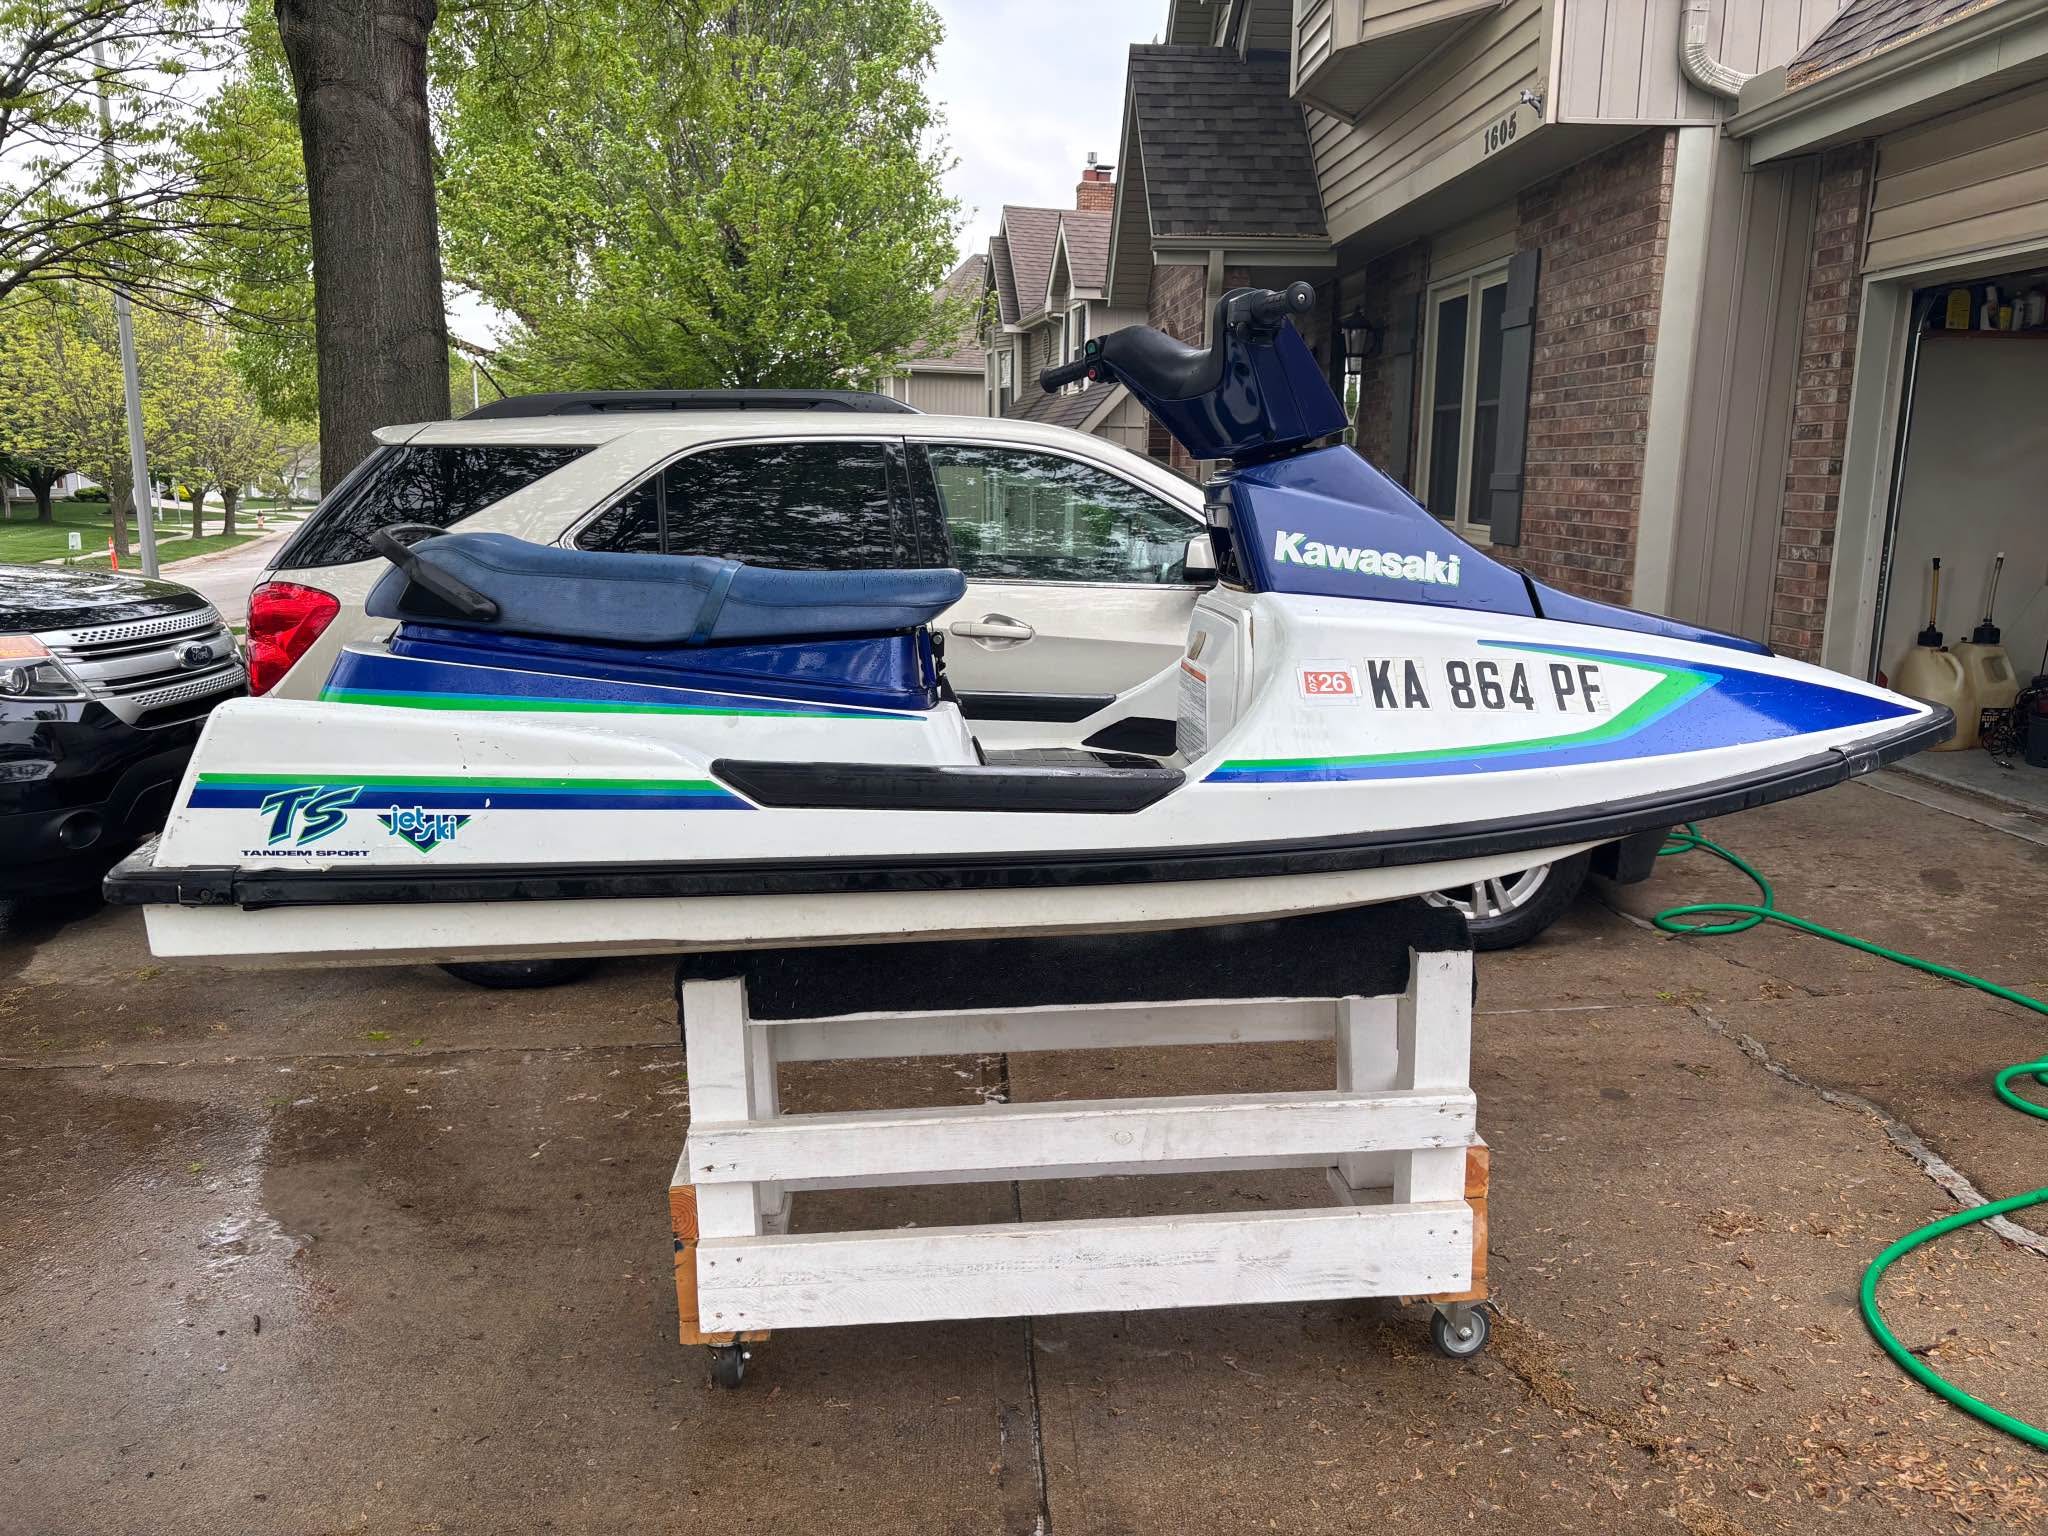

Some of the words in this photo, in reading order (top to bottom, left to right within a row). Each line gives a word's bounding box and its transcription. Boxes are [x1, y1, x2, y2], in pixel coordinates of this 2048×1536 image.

[1484, 111, 1517, 155] 1605
[1274, 530, 1461, 586] Kawasaki
[1319, 674, 1347, 692] 26
[1367, 660, 1430, 708] KA
[1446, 661, 1534, 710] 864
[1549, 663, 1600, 712] PF
[260, 785, 365, 846] TS
[389, 804, 424, 835] jet
